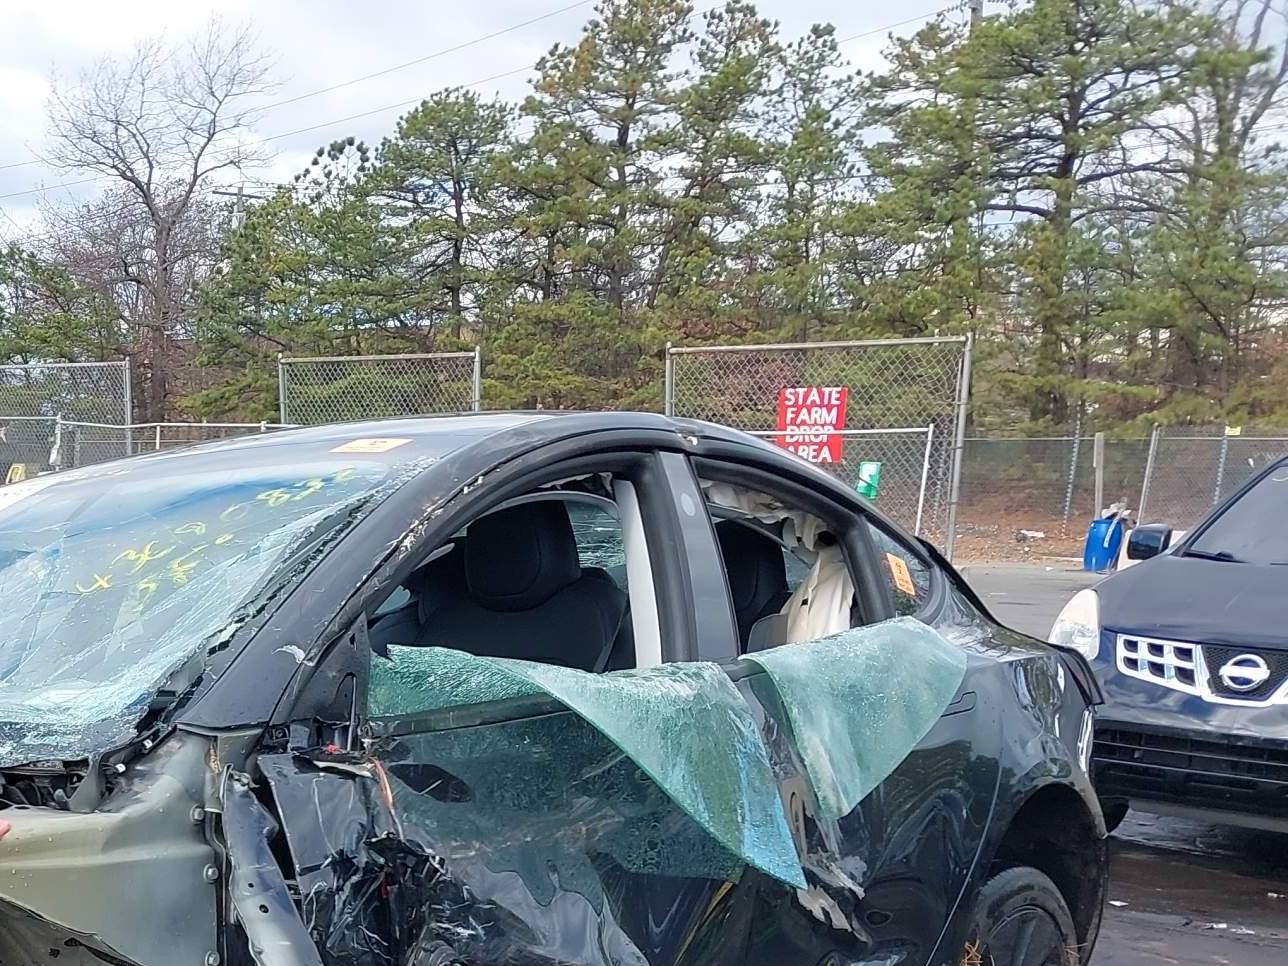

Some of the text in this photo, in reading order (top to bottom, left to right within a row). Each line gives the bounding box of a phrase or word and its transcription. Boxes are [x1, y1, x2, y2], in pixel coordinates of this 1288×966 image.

[785, 387, 841, 405] STATE
[785, 407, 837, 425] FARM
[785, 425, 834, 443] DROP
